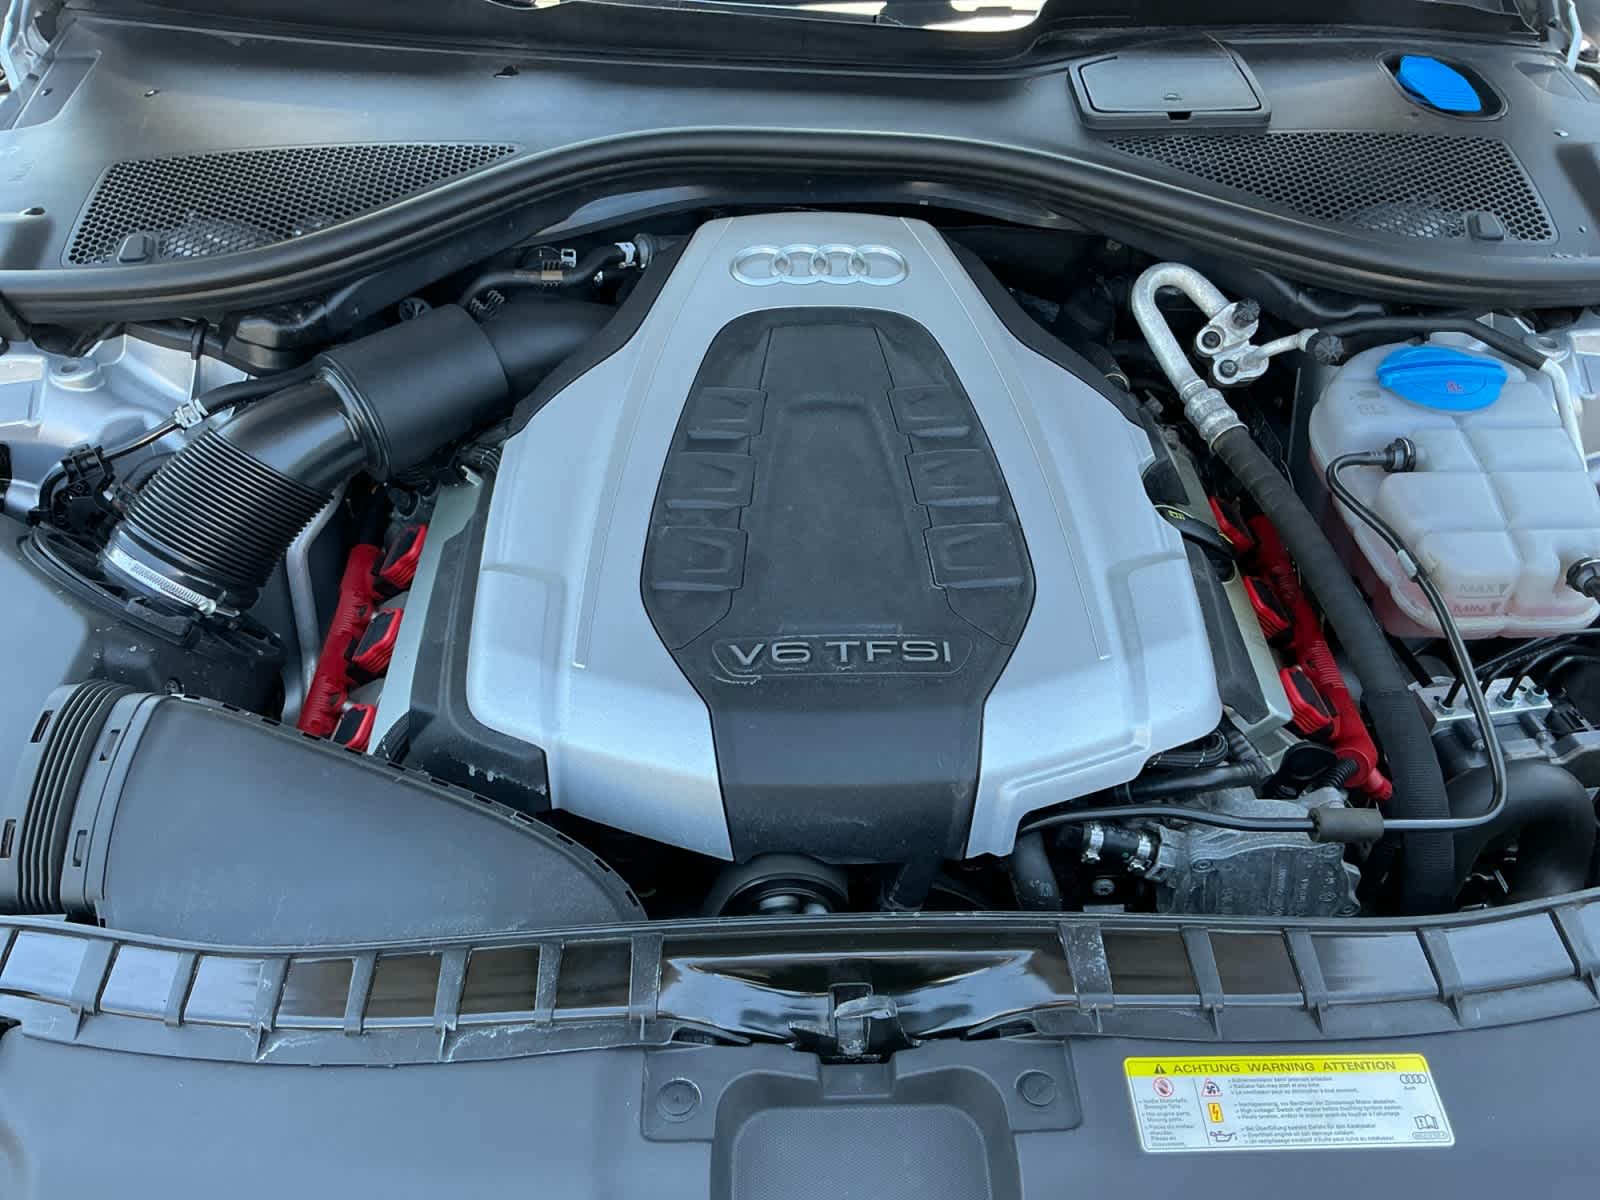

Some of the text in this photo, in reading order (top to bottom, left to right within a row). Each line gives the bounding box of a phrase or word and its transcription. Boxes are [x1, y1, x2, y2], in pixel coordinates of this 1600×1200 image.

[728, 640, 951, 666] V6 TFSI
[1173, 1060, 1396, 1074] ACHTUNG WARNING ATTENTION
